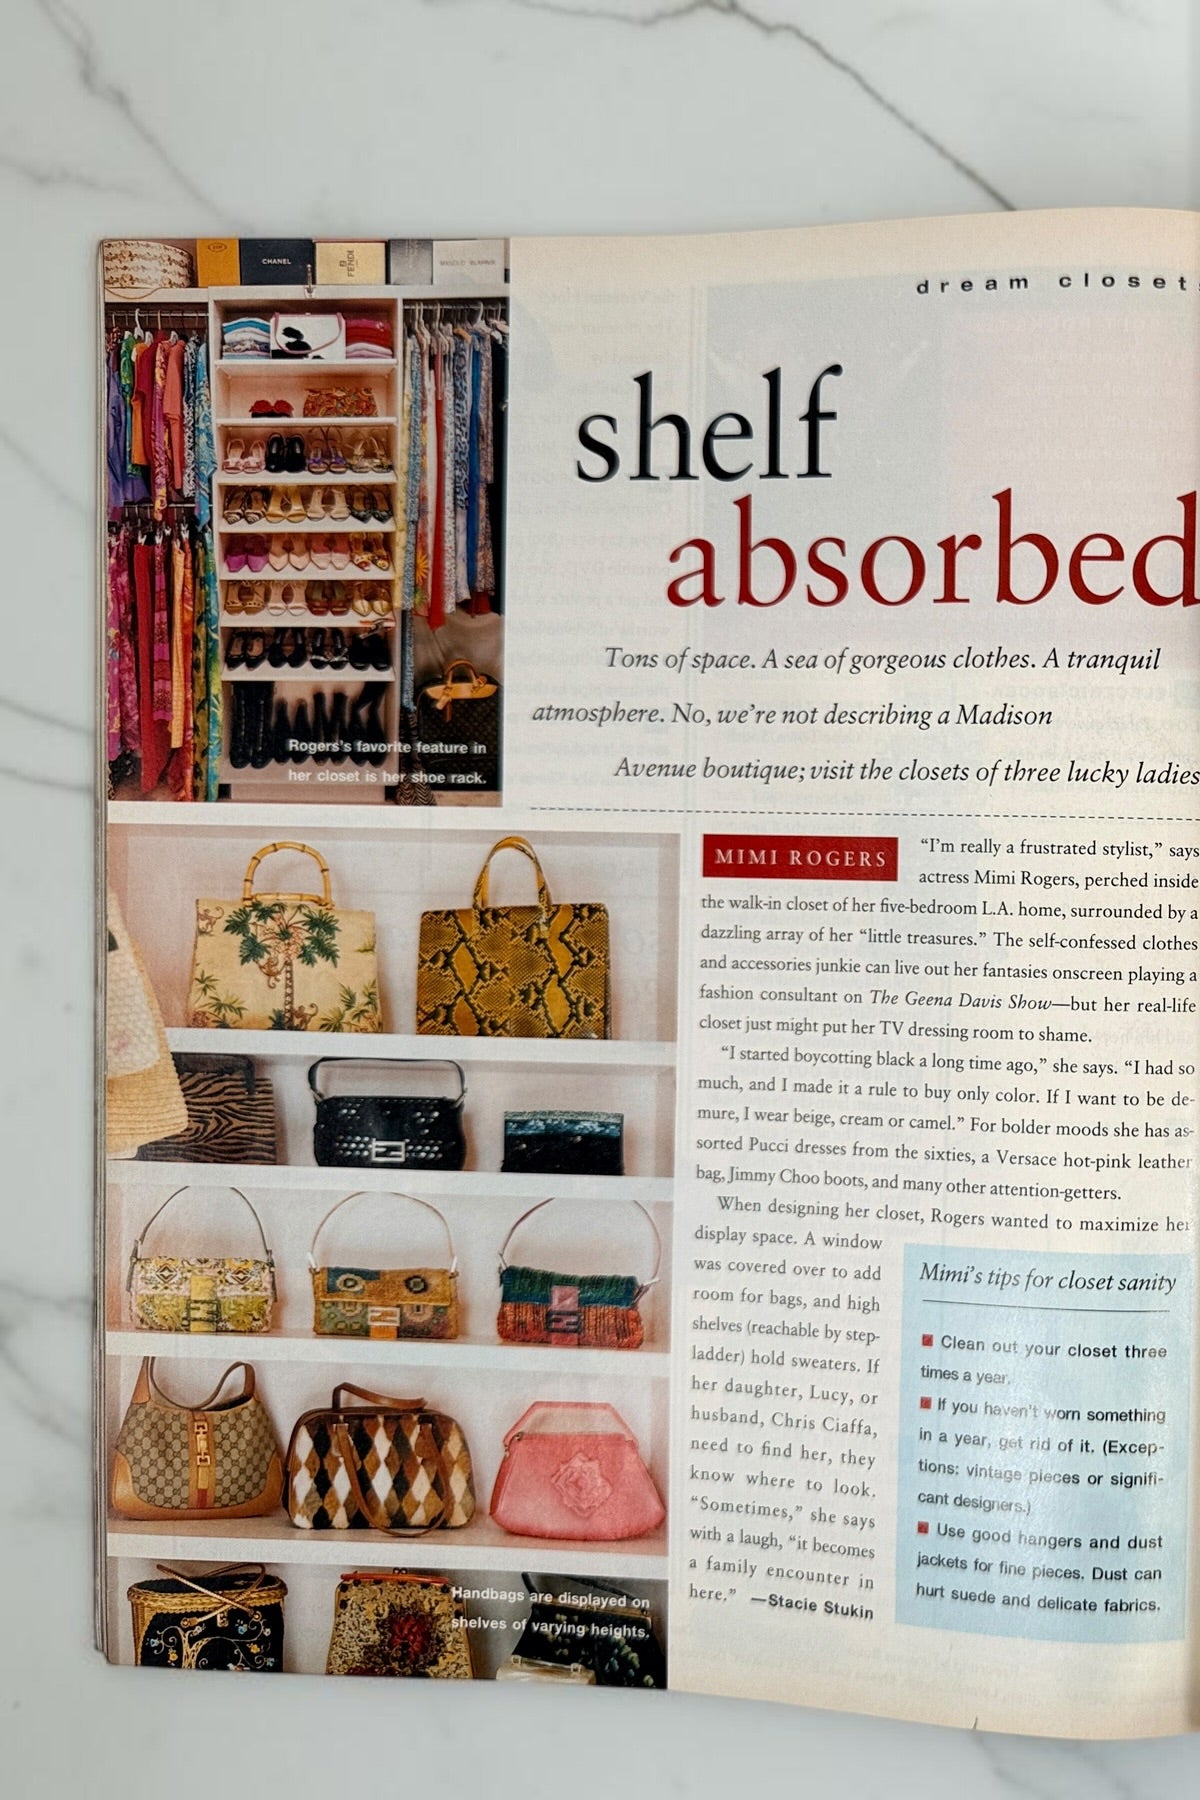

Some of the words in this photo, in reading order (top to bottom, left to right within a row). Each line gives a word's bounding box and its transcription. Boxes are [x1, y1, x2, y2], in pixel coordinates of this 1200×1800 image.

[346, 250, 355, 278] FENDI
[916, 277, 1029, 295] dream
[576, 363, 843, 483] shelf
[605, 647, 659, 669] Tons
[664, 646, 691, 674] of
[691, 651, 757, 674] space.
[761, 648, 779, 669] A
[783, 655, 818, 670] sea
[823, 646, 849, 674] of
[849, 653, 948, 675] gorgeous
[952, 646, 1036, 669] clothes.
[1042, 647, 1060, 669] A
[1067, 647, 1162, 676] tranquil
[531, 700, 665, 728] atmosphere.
[671, 702, 712, 727] No,
[717, 703, 777, 725] we’re
[782, 707, 819, 725] not
[823, 702, 933, 731] describing
[937, 710, 950, 725] a
[955, 702, 1053, 726] Madison
[287, 739, 352, 754] Rogers’s
[356, 740, 412, 753] favorite
[416, 741, 469, 754] feature
[473, 741, 487, 754] in
[288, 769, 312, 782] her
[316, 769, 360, 783] closet
[365, 770, 378, 783] is
[382, 770, 406, 783] her
[410, 771, 446, 784] shoe
[451, 771, 487, 784] rack.
[613, 756, 697, 778] Avenue
[702, 756, 806, 786] boutique;
[810, 759, 855, 780] visit
[860, 758, 893, 781] the
[898, 758, 970, 782] closets
[975, 758, 1003, 787] of
[1004, 759, 1061, 782] three
[1067, 759, 1130, 789] lucky
[1136, 760, 1200, 785] ladies
[715, 848, 777, 865] MIMI
[789, 849, 886, 867] ROGERS
[920, 837, 955, 853] “I’m
[960, 837, 1002, 857] really
[1006, 843, 1015, 855] a
[1020, 838, 1097, 856] frustrated
[1102, 840, 1163, 860] stylist,”
[1169, 847, 1200, 862] says
[918, 871, 970, 884] actress
[973, 869, 1015, 885] Mimi
[1021, 870, 1080, 890] Rogers,
[1084, 871, 1148, 891] perched
[1153, 872, 1199, 889] inside
[701, 893, 725, 910] the
[728, 894, 782, 911] walk-in
[786, 895, 829, 911] closet
[832, 896, 849, 912] of
[851, 896, 876, 913] her
[880, 896, 977, 915] five-bedroom
[982, 900, 1014, 916] L.A.
[1018, 900, 1067, 921] home,
[1070, 903, 1163, 920] surrounded
[1167, 903, 1187, 923] by
[1190, 908, 1199, 920] a
[698, 1013, 742, 1030] closet
[744, 1020, 773, 1034] just
[775, 1016, 819, 1036] might
[822, 1022, 848, 1037] put
[851, 1018, 876, 1035] her
[879, 1020, 904, 1036] TV
[907, 1020, 969, 1042] dressing
[972, 1028, 1014, 1040] room
[1018, 1029, 1035, 1041] to
[1038, 1025, 1092, 1043] shame.
[696, 1163, 726, 1184] bag,
[726, 1165, 776, 1187] Jimmy
[779, 1168, 820, 1185] Choo
[824, 1170, 869, 1191] boots,
[871, 1173, 899, 1190] and
[902, 1179, 943, 1196] many
[945, 1177, 987, 1195] other
[989, 1184, 1122, 1203] attention-getters.
[694, 1223, 747, 1245] display
[752, 1232, 798, 1248] space.
[803, 1230, 816, 1246] A
[822, 1232, 883, 1250] window
[919, 1262, 983, 1285] Mimi’s
[987, 1267, 1021, 1291] tips
[1024, 1267, 1054, 1292] for
[1058, 1269, 1115, 1291] closet
[1117, 1275, 1177, 1296] sanity
[692, 1314, 743, 1333] shelves
[746, 1319, 820, 1339] (reachable
[824, 1323, 842, 1344] by
[845, 1330, 880, 1347] step-
[940, 1334, 985, 1352] Clean
[992, 1340, 1018, 1355] out
[1025, 1343, 1061, 1359] your
[1067, 1342, 1117, 1358] closet
[1124, 1344, 1168, 1359] three
[920, 1365, 960, 1382] times
[962, 1370, 973, 1383] a
[976, 1371, 1011, 1386] year.
[691, 1374, 718, 1392] her
[724, 1377, 803, 1402] daughter,
[809, 1384, 854, 1407] Lucy,
[860, 1393, 879, 1406] or
[917, 1492, 949, 1506] cant
[936, 1522, 966, 1539] Use
[971, 1529, 1012, 1545] good
[1018, 1530, 1082, 1551] hangers
[1089, 1535, 1120, 1550] and
[1127, 1535, 1163, 1550] dust
[916, 1551, 968, 1571] jackets
[973, 1557, 994, 1573] for
[999, 1560, 1026, 1577] fine
[1032, 1566, 1085, 1581] pieces.
[1092, 1567, 1128, 1581] Dust
[1134, 1569, 1162, 1582] can
[451, 1586, 525, 1603] Handbags
[529, 1591, 553, 1603] are
[558, 1592, 627, 1609] displayed
[631, 1597, 650, 1609] on
[750, 1593, 818, 1612] —Stacie
[823, 1600, 874, 1620] Stukin
[916, 1581, 945, 1598] hurt
[951, 1588, 996, 1605] suede
[1001, 1593, 1031, 1608] and
[1037, 1595, 1098, 1612] delicate
[1104, 1598, 1161, 1613] fabrics.
[451, 1616, 507, 1629] shelves
[512, 1618, 527, 1631] of
[532, 1621, 586, 1637] varying
[591, 1622, 650, 1639] heights.
